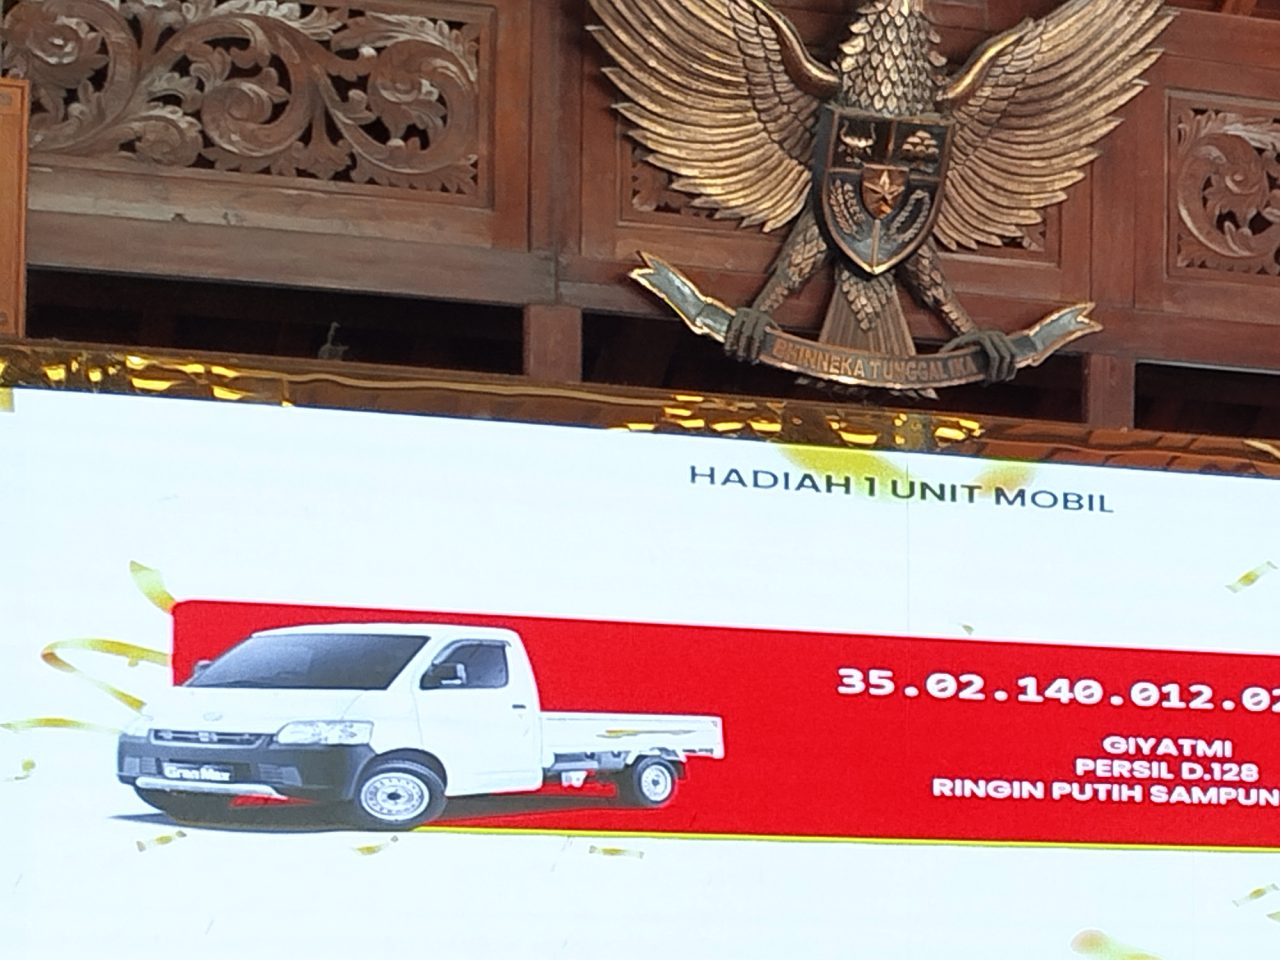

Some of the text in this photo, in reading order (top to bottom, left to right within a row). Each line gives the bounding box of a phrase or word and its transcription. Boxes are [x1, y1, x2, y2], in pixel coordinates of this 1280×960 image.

[772, 337, 978, 382] BHINNEKA TUNGGAL IKA
[689, 465, 1115, 514] HADIAH 1 UNIT MOBIL
[1102, 735, 1233, 758] GIYATMI
[1075, 758, 1259, 782] PERSIL D.128
[932, 778, 1044, 799] RINGIN
[1052, 781, 1143, 803] PUTIH
